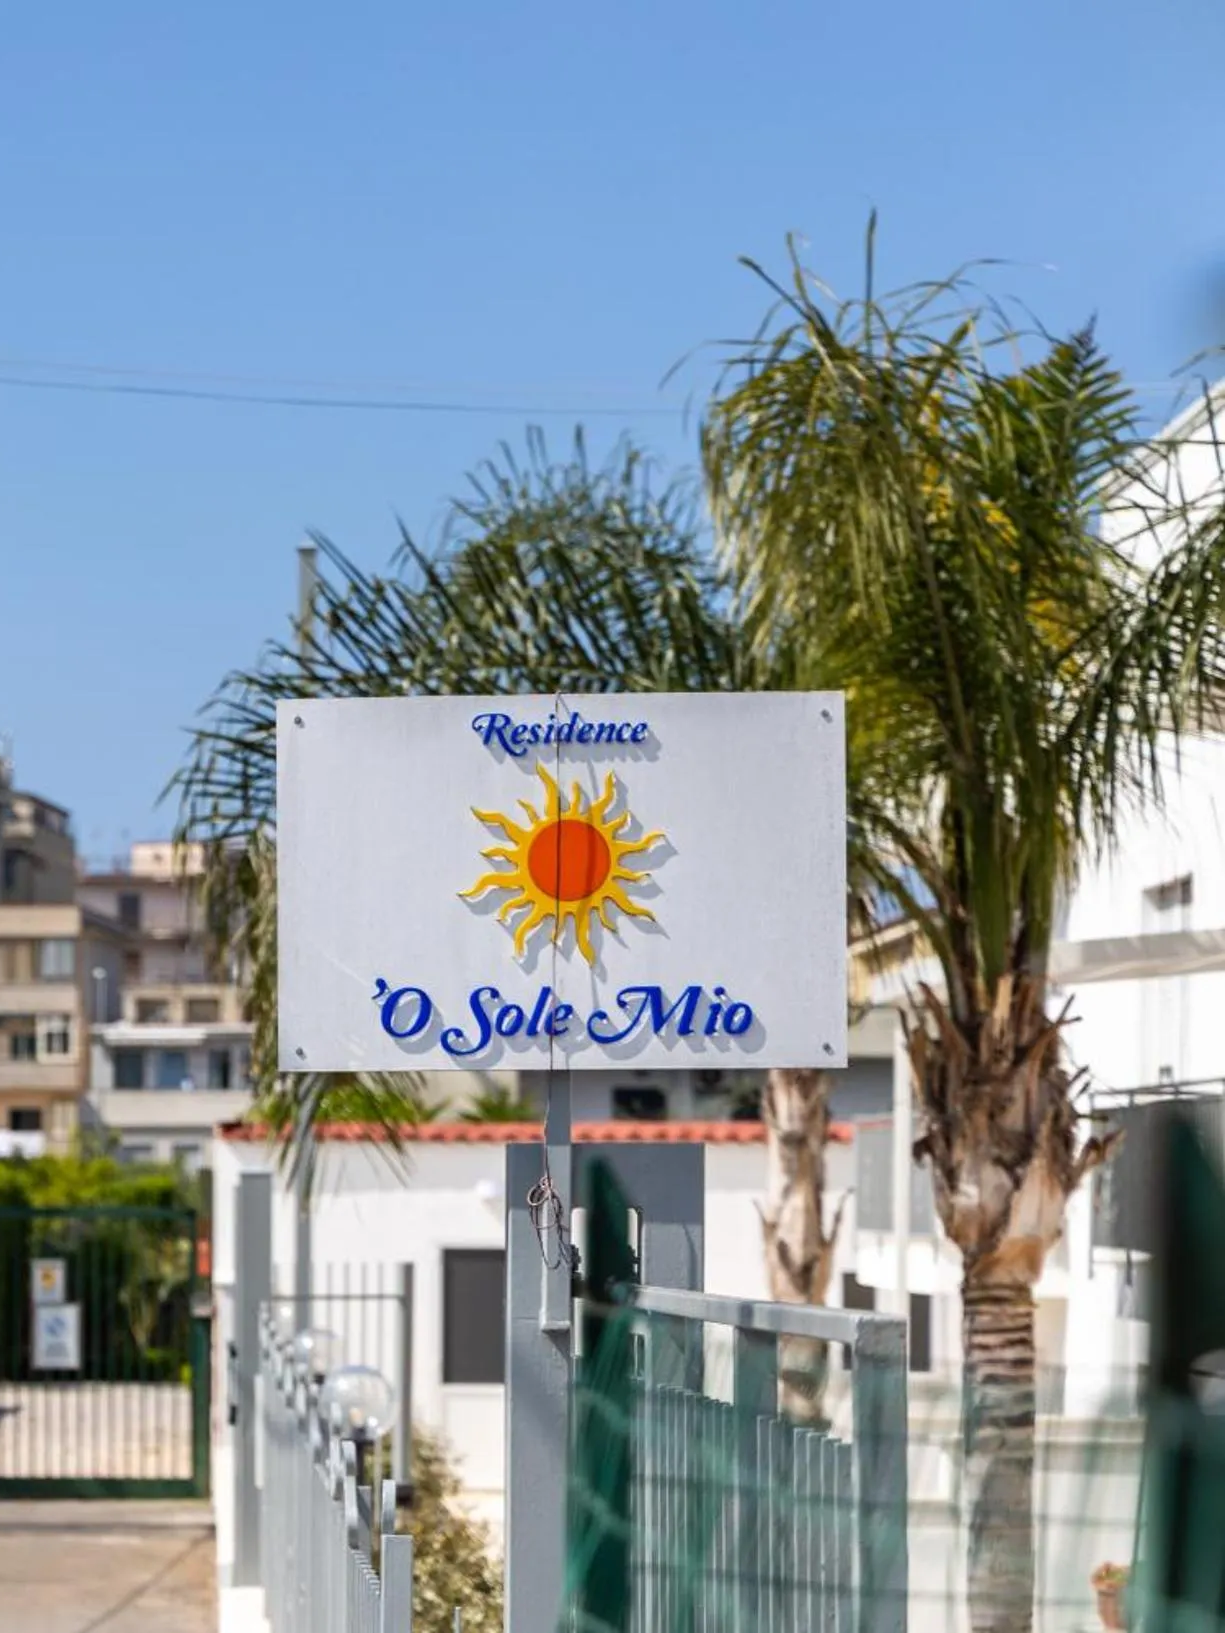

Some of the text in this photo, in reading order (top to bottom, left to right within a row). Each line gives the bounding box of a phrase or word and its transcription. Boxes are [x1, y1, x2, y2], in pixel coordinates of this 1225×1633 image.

[472, 712, 649, 757] Residence
[440, 985, 574, 1056] Sole
[587, 985, 753, 1044] Mio
